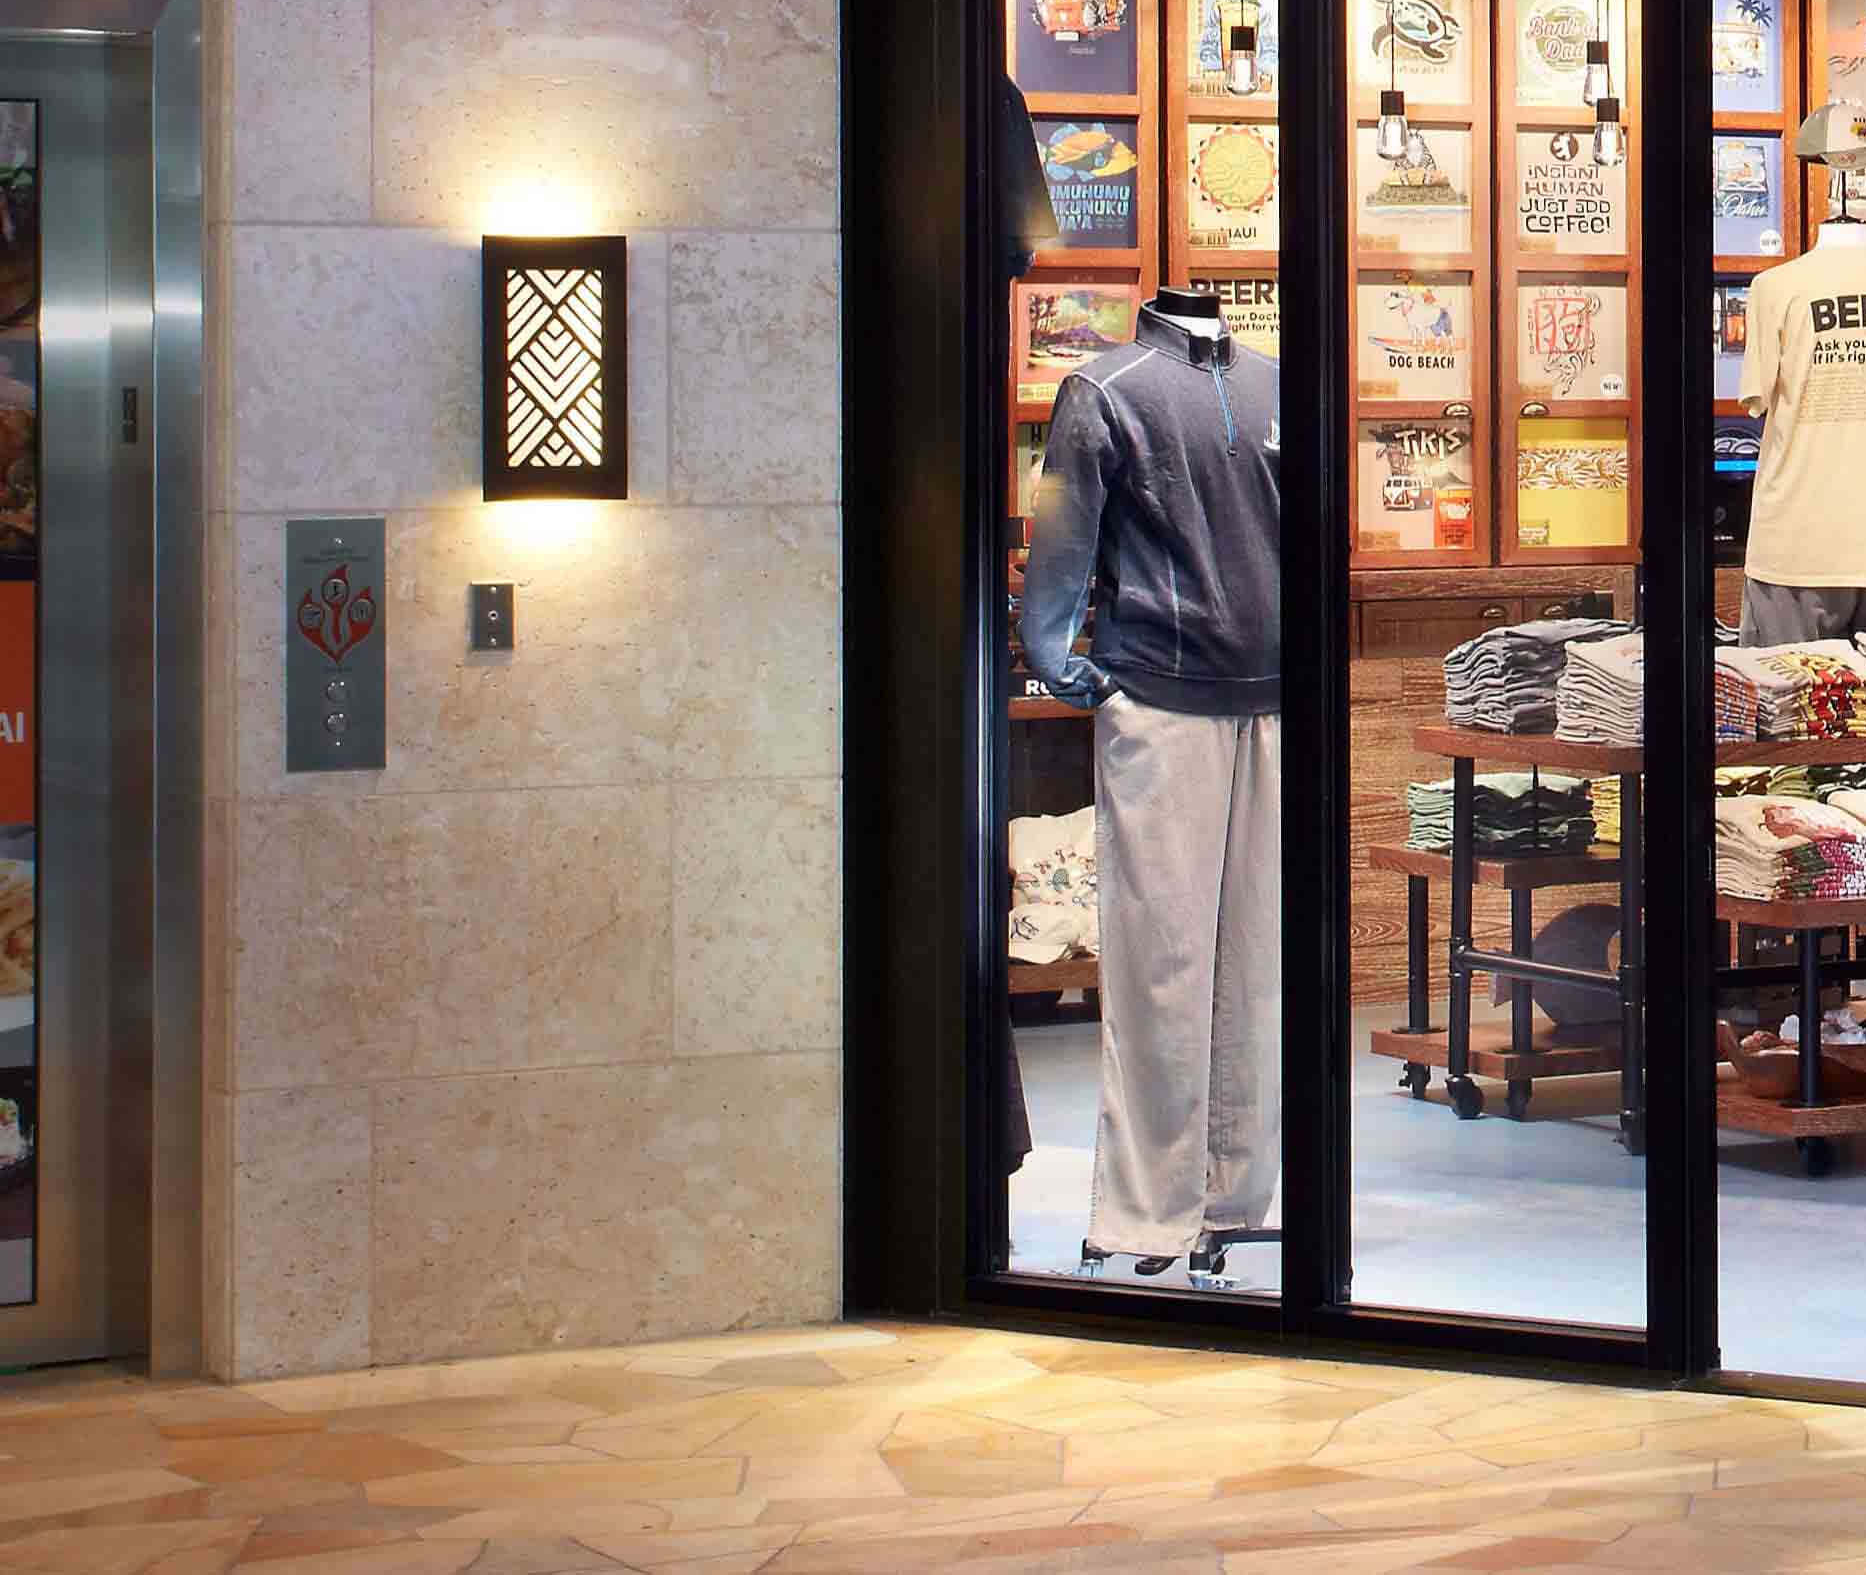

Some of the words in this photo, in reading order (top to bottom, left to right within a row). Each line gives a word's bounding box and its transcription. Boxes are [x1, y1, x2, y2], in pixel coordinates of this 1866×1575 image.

[1814, 339, 1841, 353] Ask
[1388, 354, 1414, 369] DOG
[1417, 354, 1455, 370] BEACH
